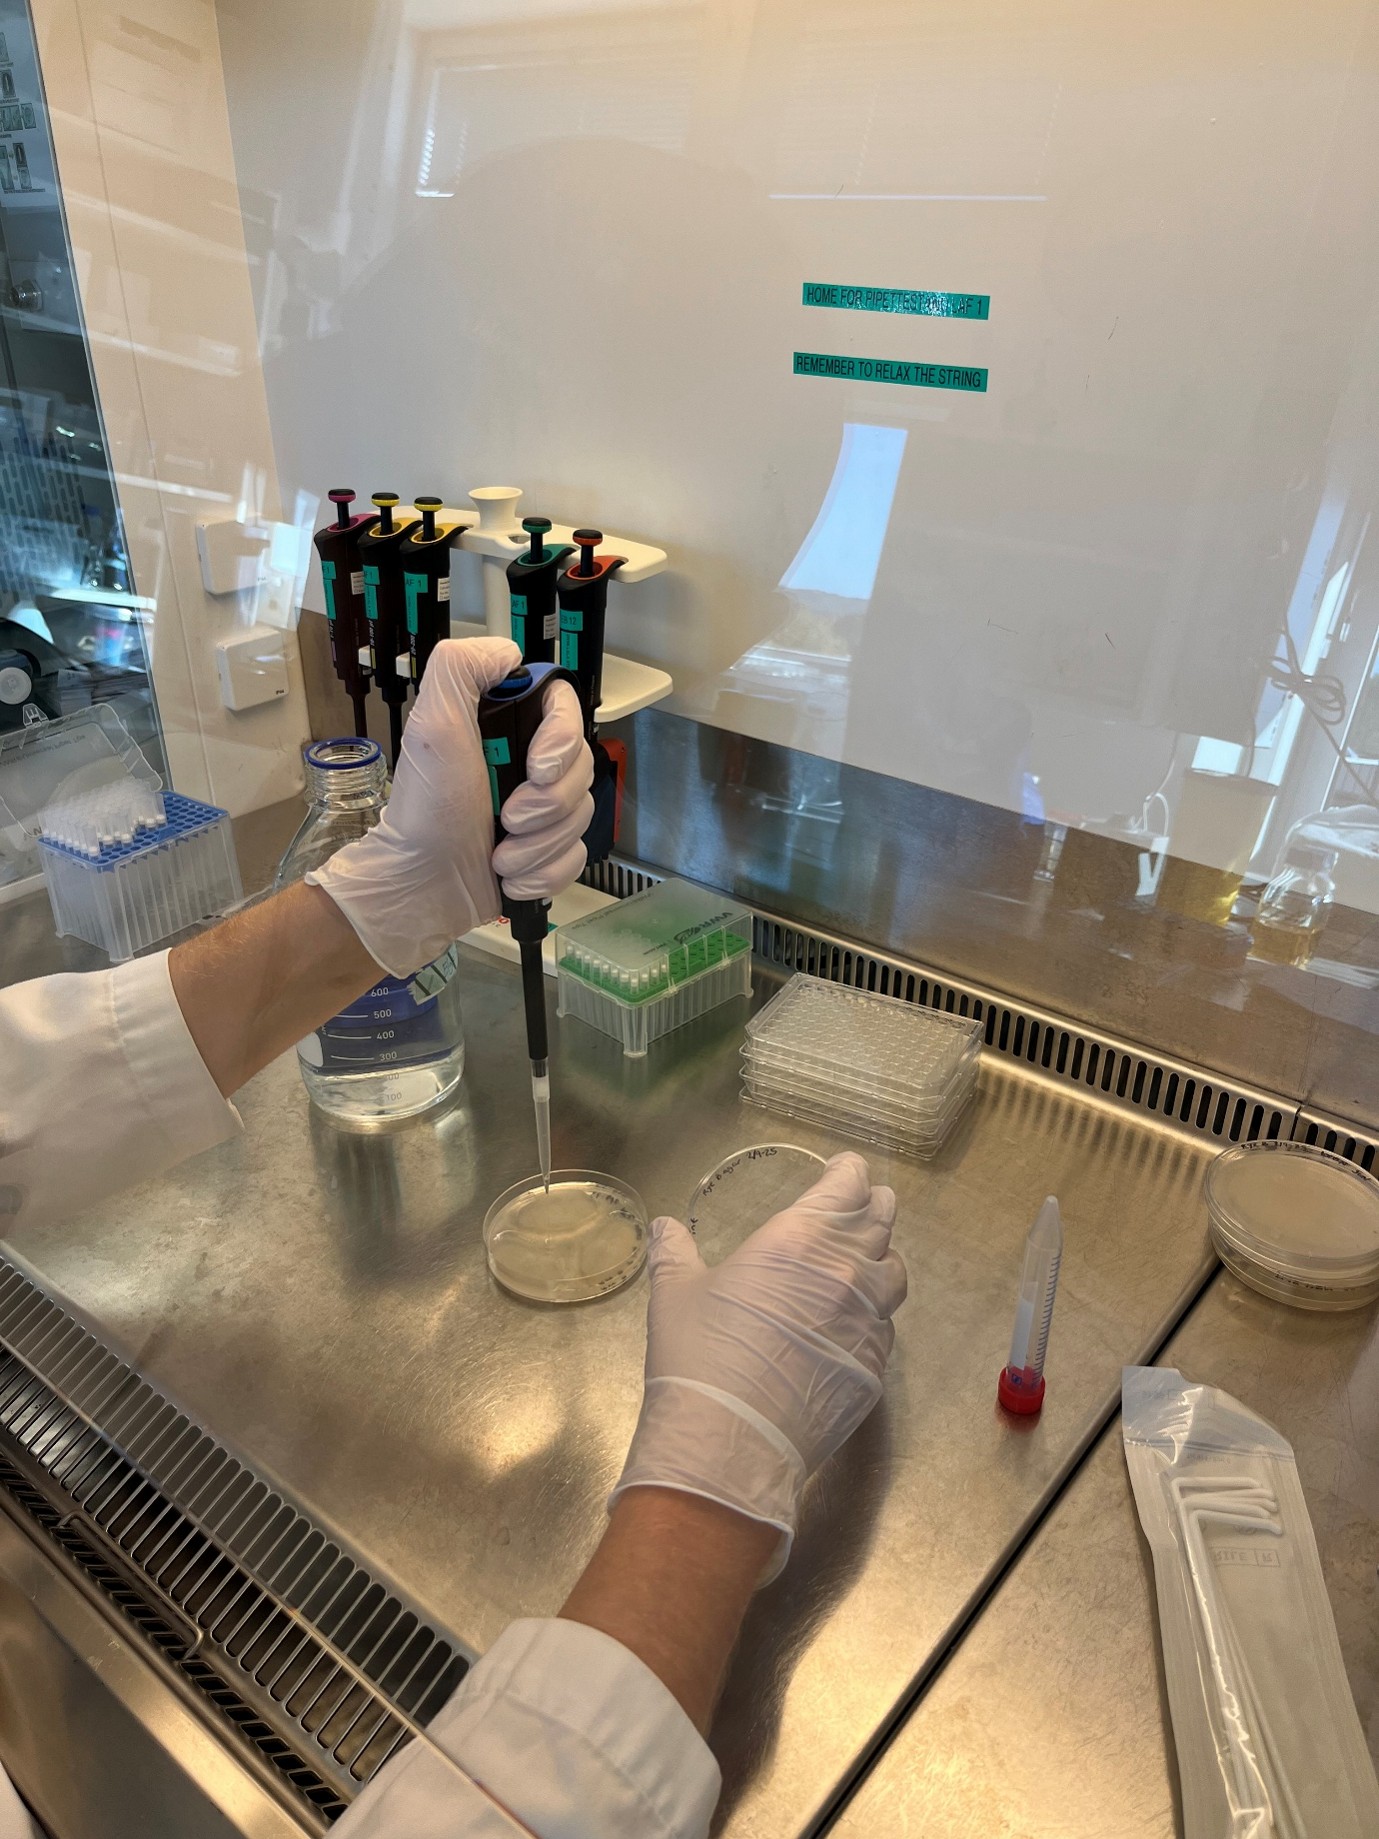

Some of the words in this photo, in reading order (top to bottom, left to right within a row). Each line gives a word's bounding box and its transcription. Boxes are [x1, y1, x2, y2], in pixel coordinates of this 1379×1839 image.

[806, 287, 837, 304] HOME
[841, 289, 862, 306] FOR
[952, 297, 974, 315] LAF
[977, 299, 983, 315] 1
[796, 355, 855, 376] REMEMBER
[858, 361, 873, 377] TO
[875, 363, 910, 381] RELAX
[914, 366, 936, 384] THE
[938, 369, 981, 388] STRING
[569, 616, 577, 625] 12
[371, 987, 389, 998] 600
[373, 1008, 392, 1019] 500
[376, 1030, 395, 1040] 400
[379, 1051, 398, 1061] 300
